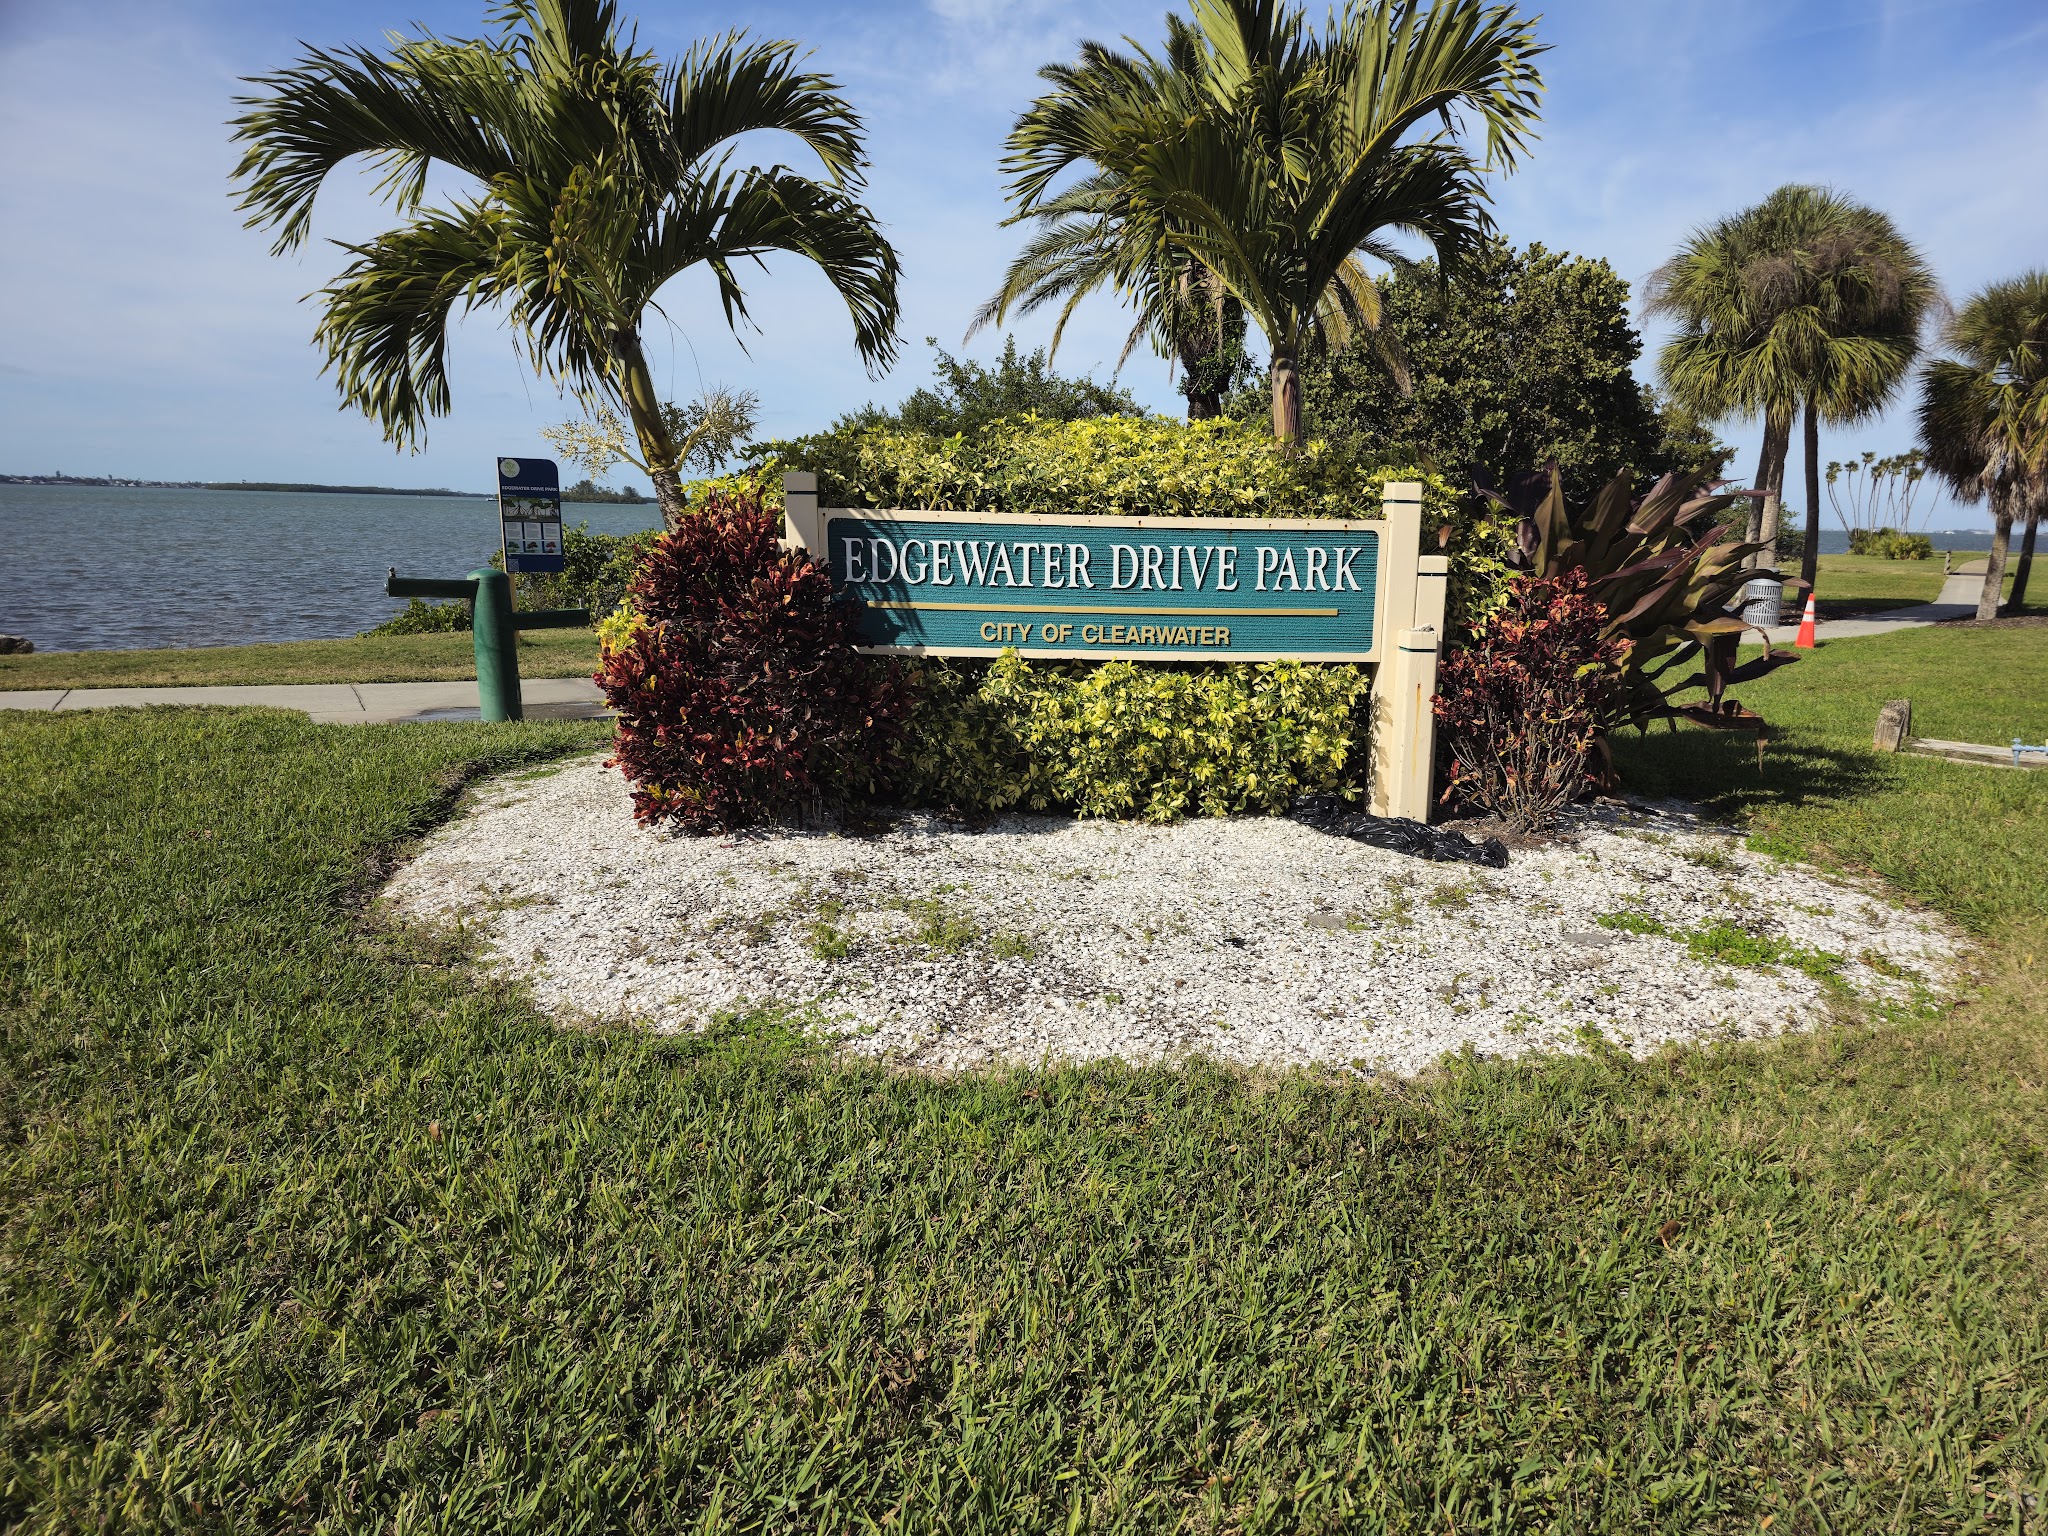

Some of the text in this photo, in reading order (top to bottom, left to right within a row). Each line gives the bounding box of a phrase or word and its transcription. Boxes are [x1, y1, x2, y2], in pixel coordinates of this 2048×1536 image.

[841, 537, 1362, 592] EDGEWATER DRIVE PARK
[980, 622, 1231, 645] CITY OF CLEARWATER
